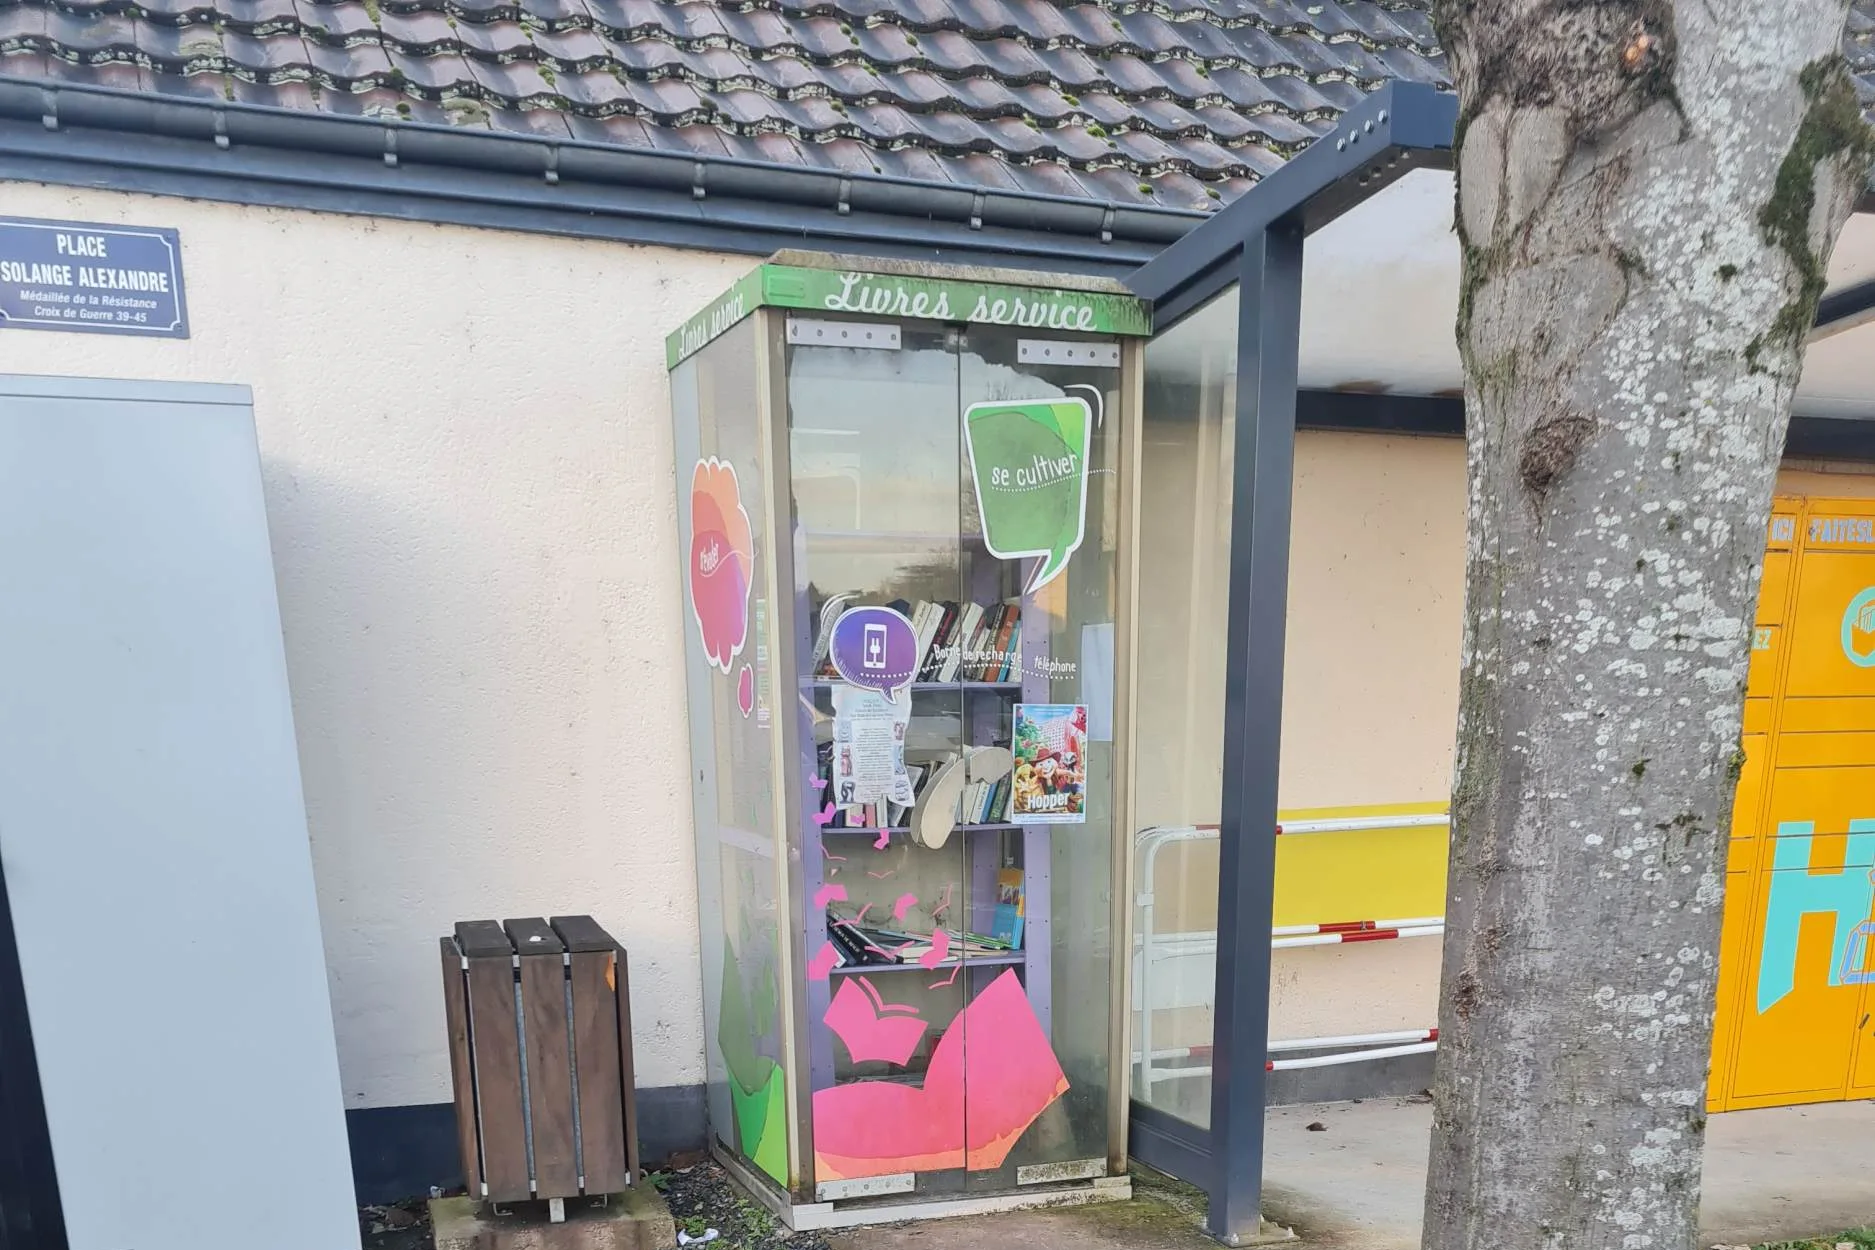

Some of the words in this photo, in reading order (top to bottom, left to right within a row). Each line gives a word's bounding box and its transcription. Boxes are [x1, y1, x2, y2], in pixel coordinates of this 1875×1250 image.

[56, 234, 107, 258] PLACE
[0, 261, 73, 286] SOLANGE
[79, 266, 169, 293] ALEXANDRE
[20, 290, 70, 304] Médaillée
[73, 294, 86, 305] de
[88, 294, 99, 305] la
[102, 295, 157, 309] Résistance
[824, 272, 956, 320] Livres
[966, 289, 1099, 332] service
[34, 305, 60, 318] Croix
[63, 307, 76, 318] de
[79, 309, 113, 321] Guerre
[116, 311, 147, 323] 39-45
[991, 466, 1010, 486] se
[1016, 453, 1078, 486] cultiver
[1771, 518, 1795, 542] ICI
[933, 643, 961, 661] Borne
[963, 648, 973, 661] de
[975, 646, 1022, 666] recharge
[1034, 656, 1077, 675] téléphone
[1027, 793, 1070, 810] Hopper
